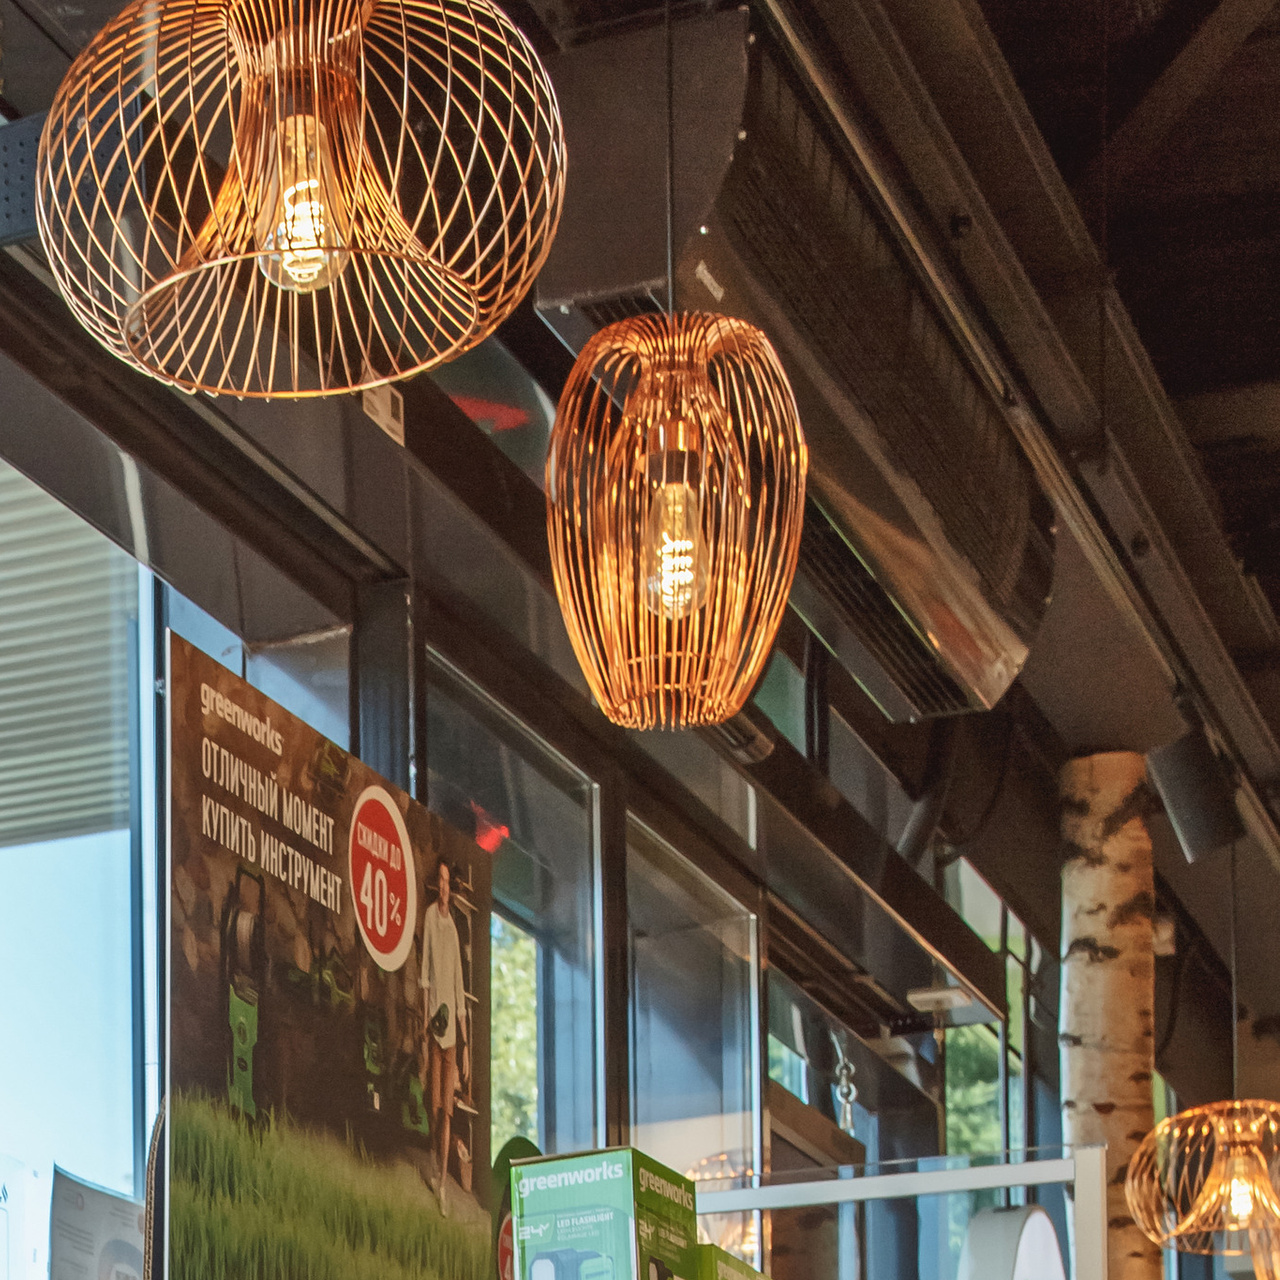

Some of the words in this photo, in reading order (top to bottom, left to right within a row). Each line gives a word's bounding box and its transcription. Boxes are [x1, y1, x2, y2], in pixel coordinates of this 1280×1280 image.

[200, 682, 282, 757] greenworks
[202, 736, 279, 822] ОТЛИЧНЫЙ
[282, 787, 335, 856] МОМЕНТ
[202, 794, 256, 864] КУПИТЬ
[260, 829, 342, 915] ИНСТРУМЕНТ
[357, 821, 388, 865] СКИДКИ
[389, 839, 402, 872] ДО
[519, 1161, 624, 1198] greenworks
[638, 1166, 694, 1211] greenworks
[556, 1218, 570, 1228] LED
[571, 1211, 614, 1226] FLASHLIGHT
